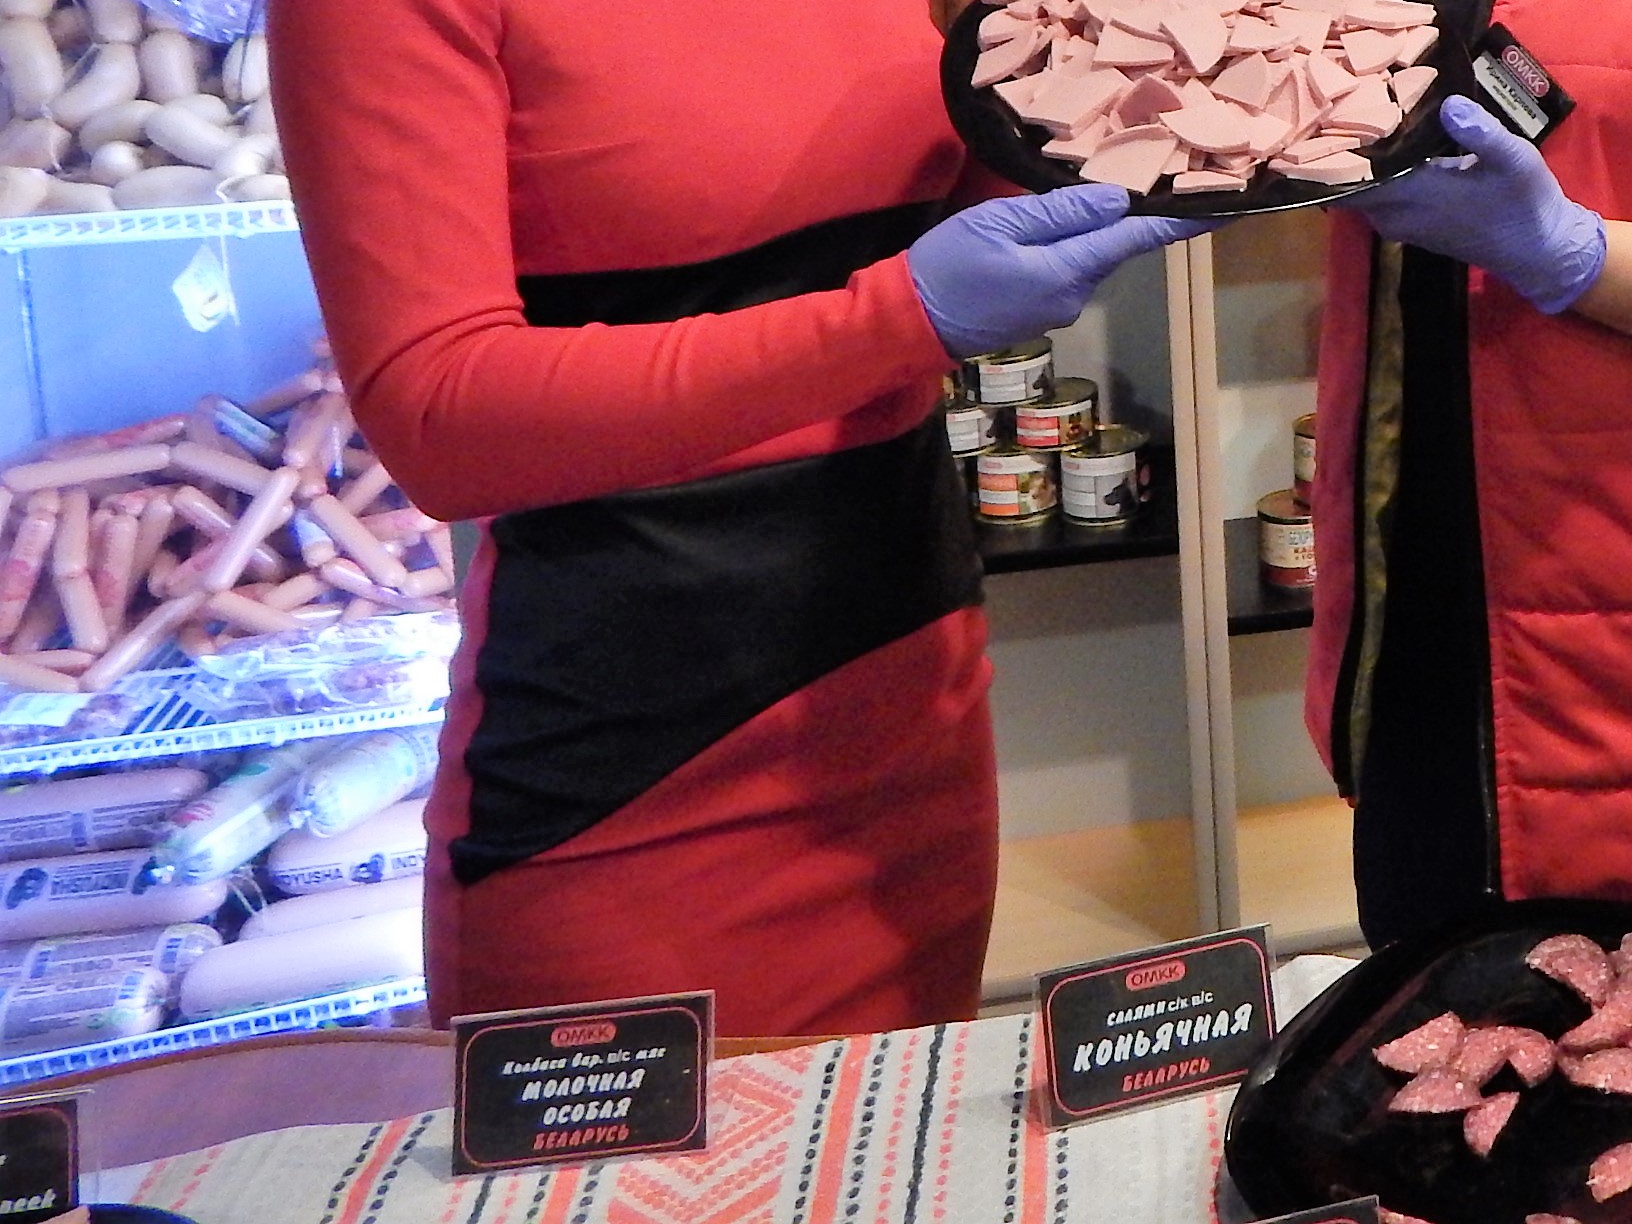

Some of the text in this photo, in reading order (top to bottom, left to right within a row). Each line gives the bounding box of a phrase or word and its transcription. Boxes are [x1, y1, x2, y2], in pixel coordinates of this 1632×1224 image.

[1073, 1002, 1253, 1073] КОНЬЯЧНАЯ
[521, 1068, 646, 1102] МОЛОЧНАЯ
[1122, 1057, 1211, 1092] БЕЛАРУСЬ
[543, 1096, 632, 1126] ОСОБАЯ
[533, 1126, 630, 1151] БЕЛАРУСЬ
